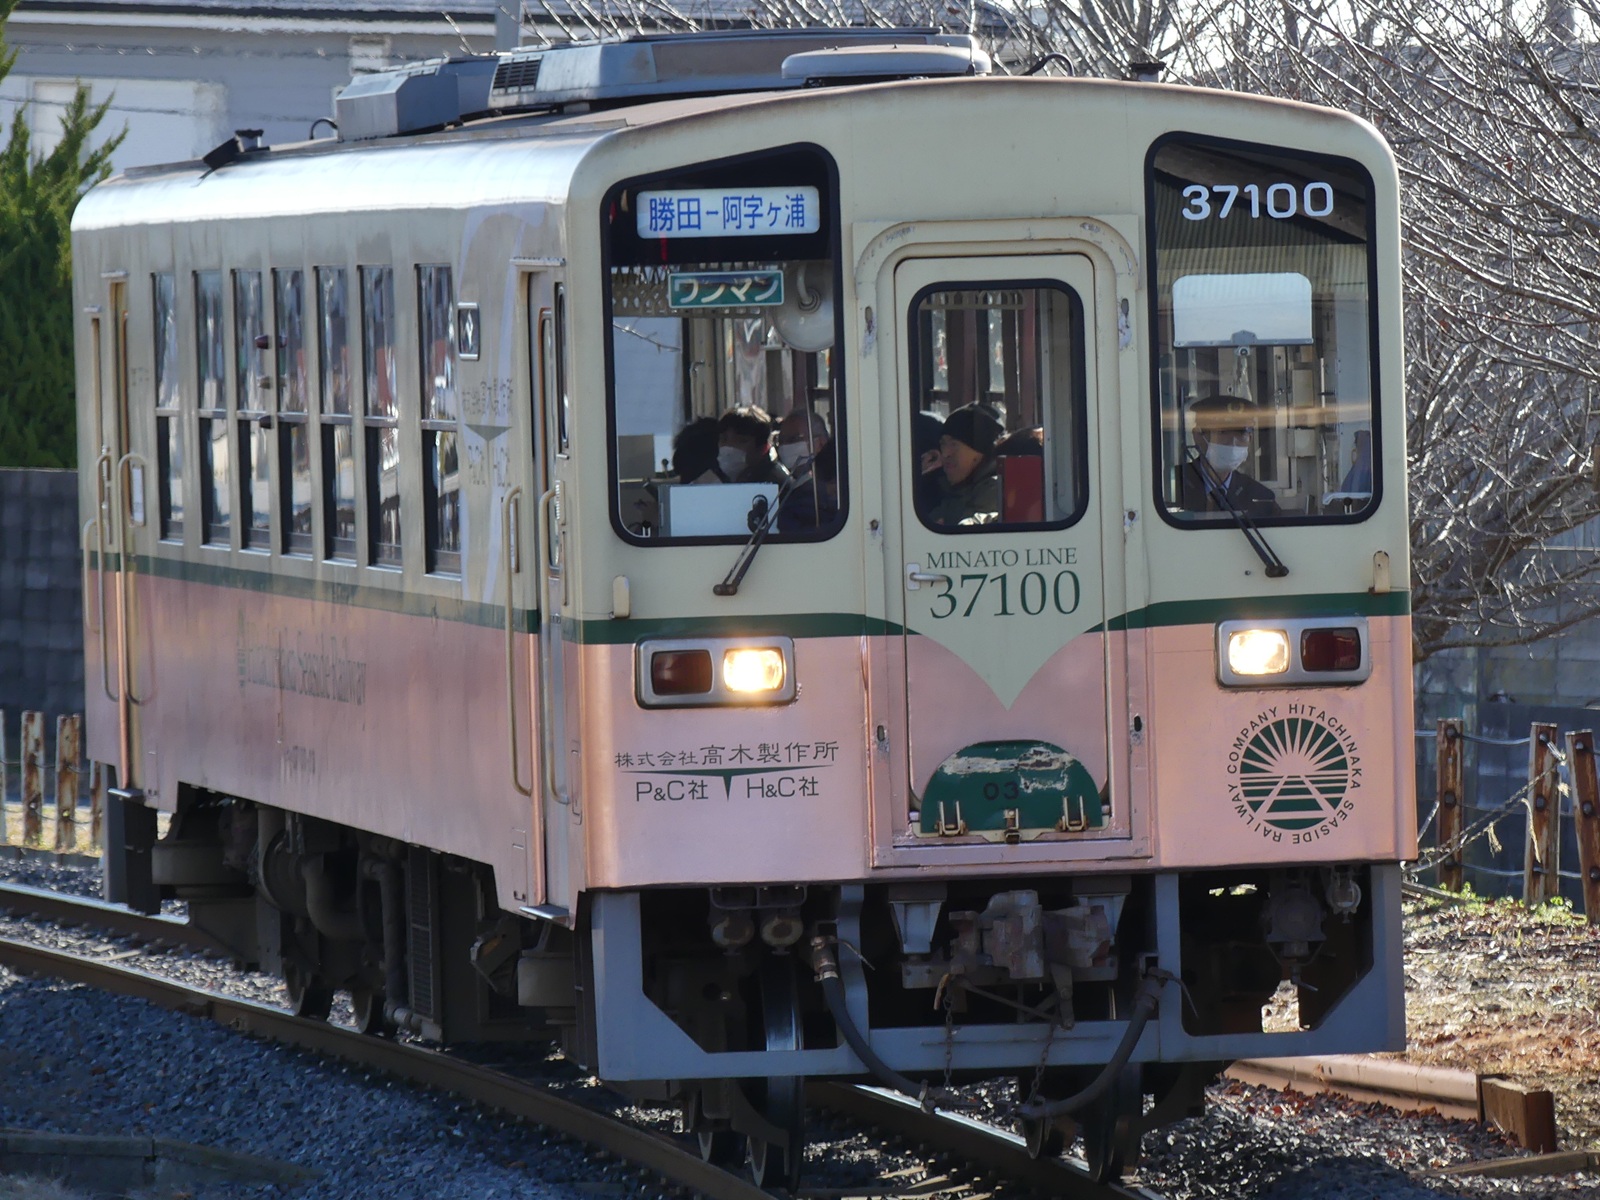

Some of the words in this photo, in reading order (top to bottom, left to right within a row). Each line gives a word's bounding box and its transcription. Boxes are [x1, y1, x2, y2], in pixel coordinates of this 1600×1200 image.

[649, 197, 701, 232] 勝田
[1182, 182, 1334, 221] 37100
[927, 549, 1019, 569] MINATO
[1026, 547, 1077, 566] LINE
[930, 570, 1080, 619] 37100
[614, 741, 839, 768] 株式会社高木製作所
[1227, 706, 1277, 774] COMPANY
[1289, 703, 1362, 789] HITACHINAKA
[636, 779, 709, 801] P&C社
[747, 776, 820, 799] H&C社
[1228, 784, 1282, 842] RAILWAY
[1292, 800, 1354, 844] SEASIDE
